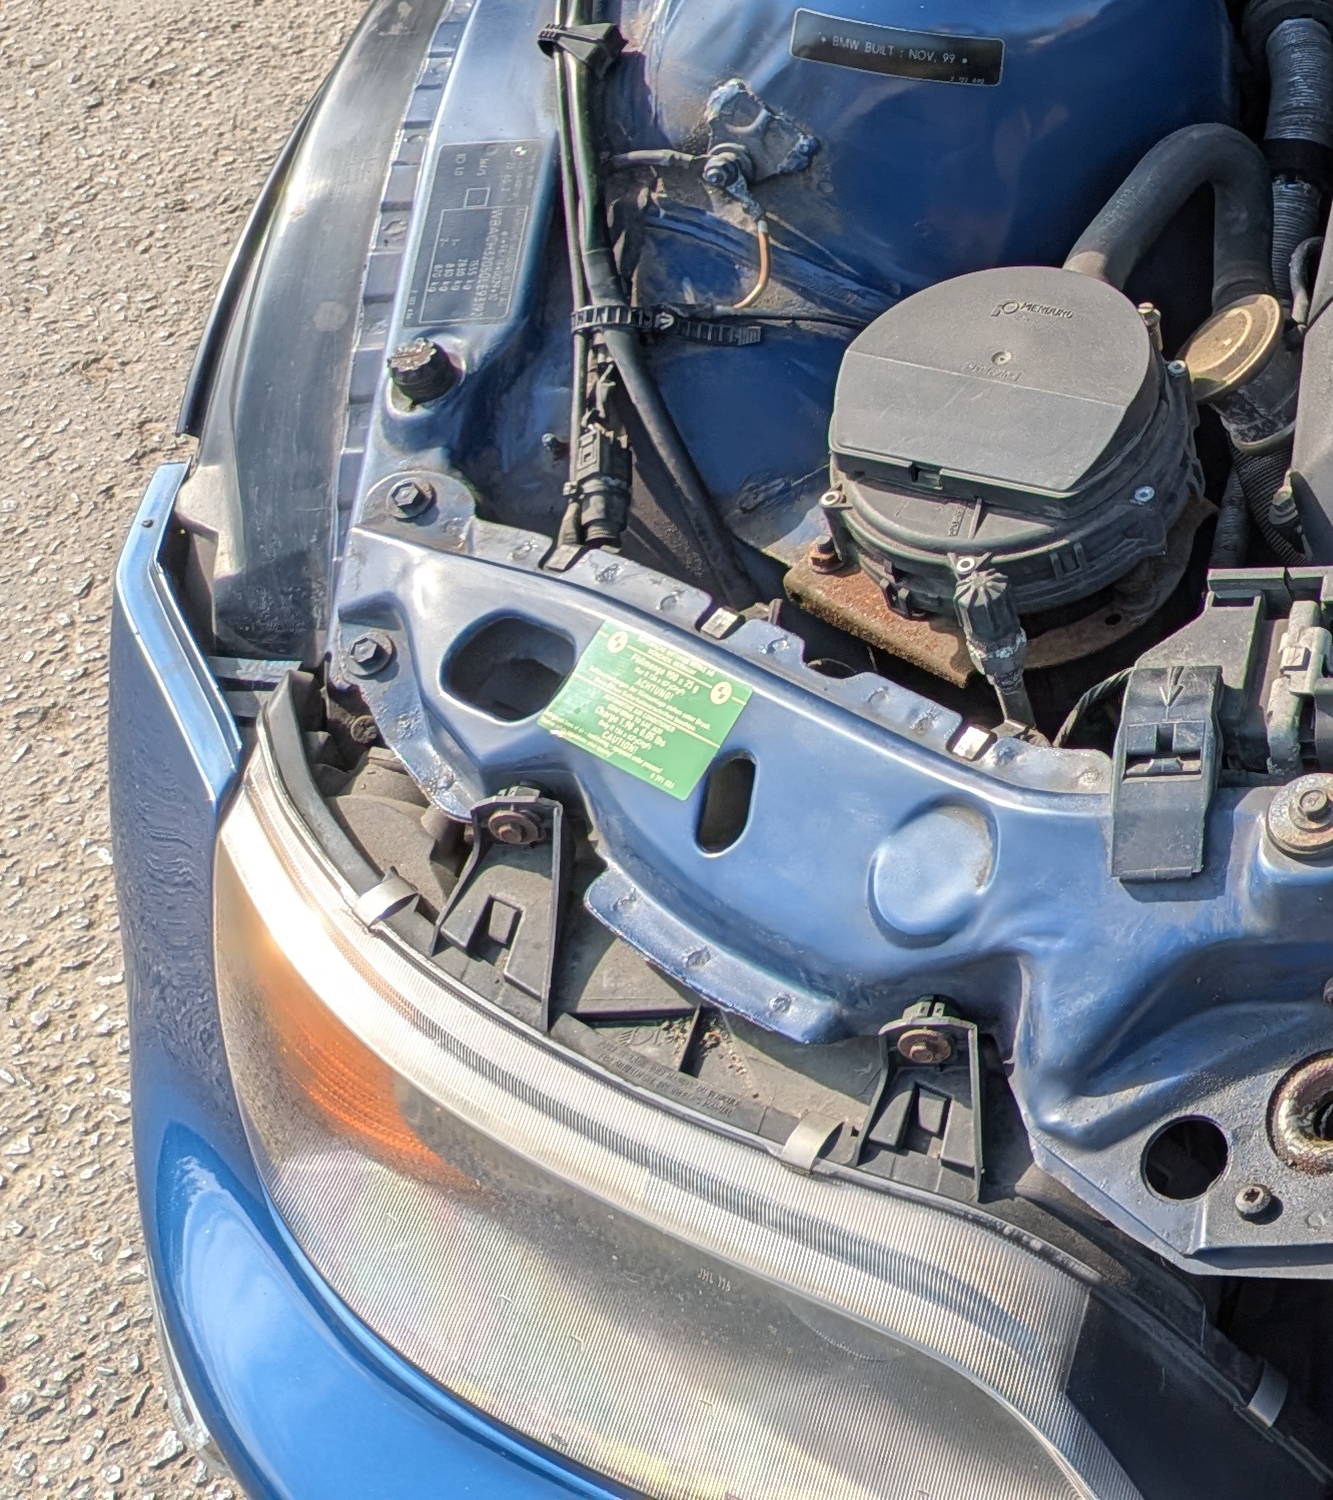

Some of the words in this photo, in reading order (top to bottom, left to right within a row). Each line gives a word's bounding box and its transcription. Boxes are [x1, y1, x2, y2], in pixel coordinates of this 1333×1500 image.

[832, 35, 861, 51] BMW
[634, 677, 674, 701] ACHTUNG!
[593, 705, 620, 724] Charge
[601, 730, 638, 753] CAUTION!
